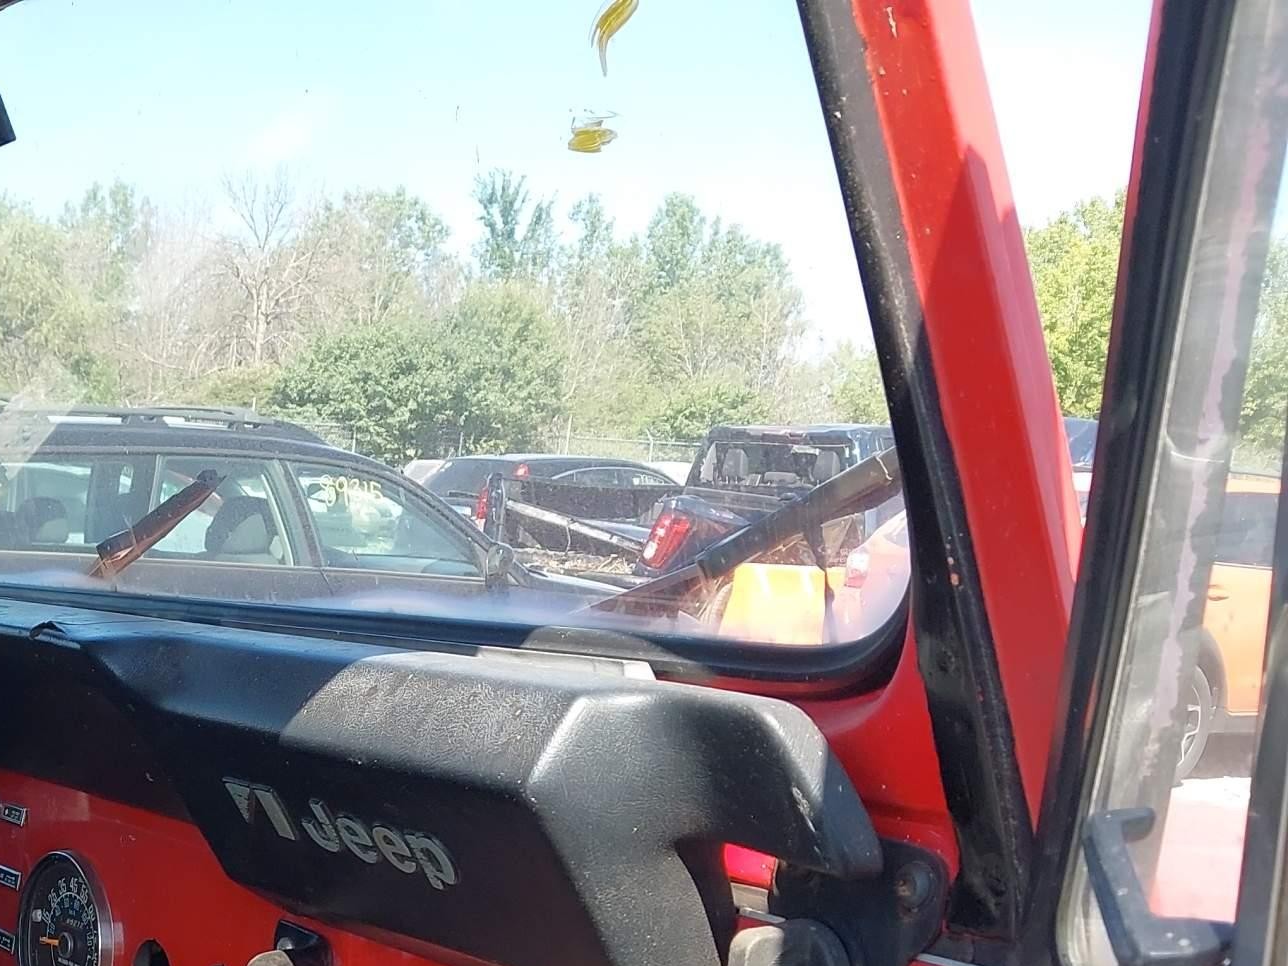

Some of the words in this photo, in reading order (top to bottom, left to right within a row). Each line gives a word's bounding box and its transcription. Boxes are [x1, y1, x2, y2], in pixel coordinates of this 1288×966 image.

[301, 798, 458, 890] Jeep
[58, 877, 67, 896] 35
[70, 877, 78, 893] 45
[48, 888, 58, 907] 25
